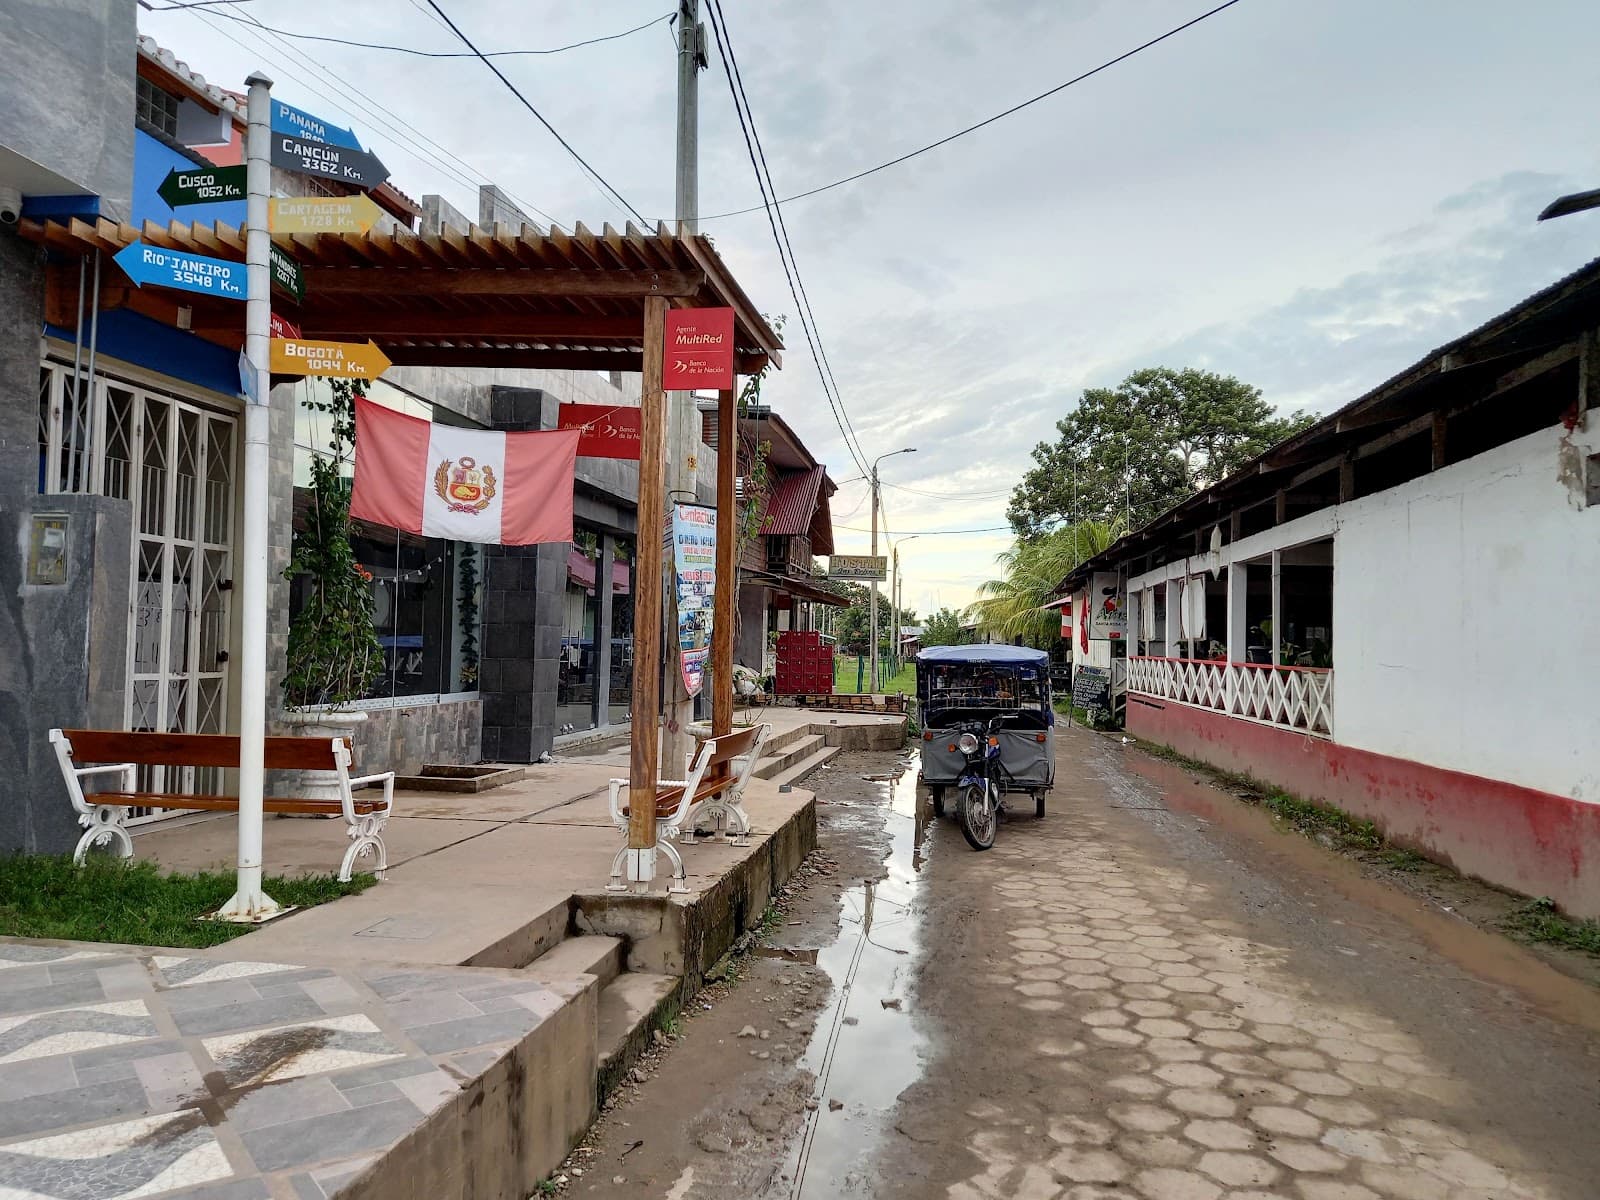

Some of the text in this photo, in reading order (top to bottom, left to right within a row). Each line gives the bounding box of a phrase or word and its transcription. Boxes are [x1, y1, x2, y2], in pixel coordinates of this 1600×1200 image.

[302, 158, 338, 175] 3362
[197, 186, 223, 198] 1052
[302, 215, 332, 226] 1728
[174, 270, 212, 287] 3548
[676, 326, 697, 334] Agente
[675, 333, 723, 345] MultiRed
[307, 359, 341, 371] 1094
